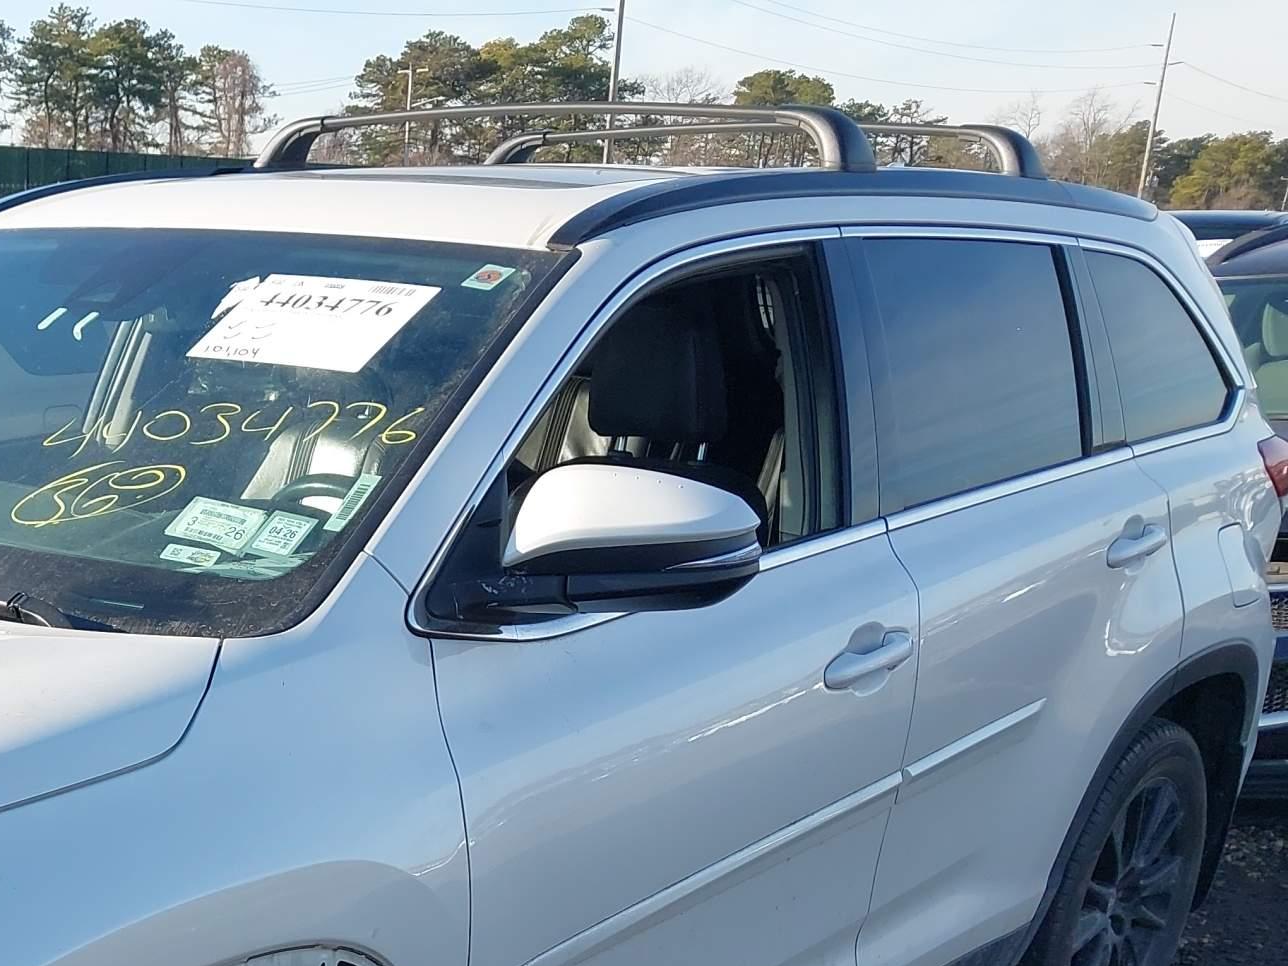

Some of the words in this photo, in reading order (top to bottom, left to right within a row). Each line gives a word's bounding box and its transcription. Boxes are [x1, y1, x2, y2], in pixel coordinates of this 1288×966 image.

[260, 293, 398, 317] 44034776
[187, 516, 199, 527] 3
[224, 526, 246, 541] 26
